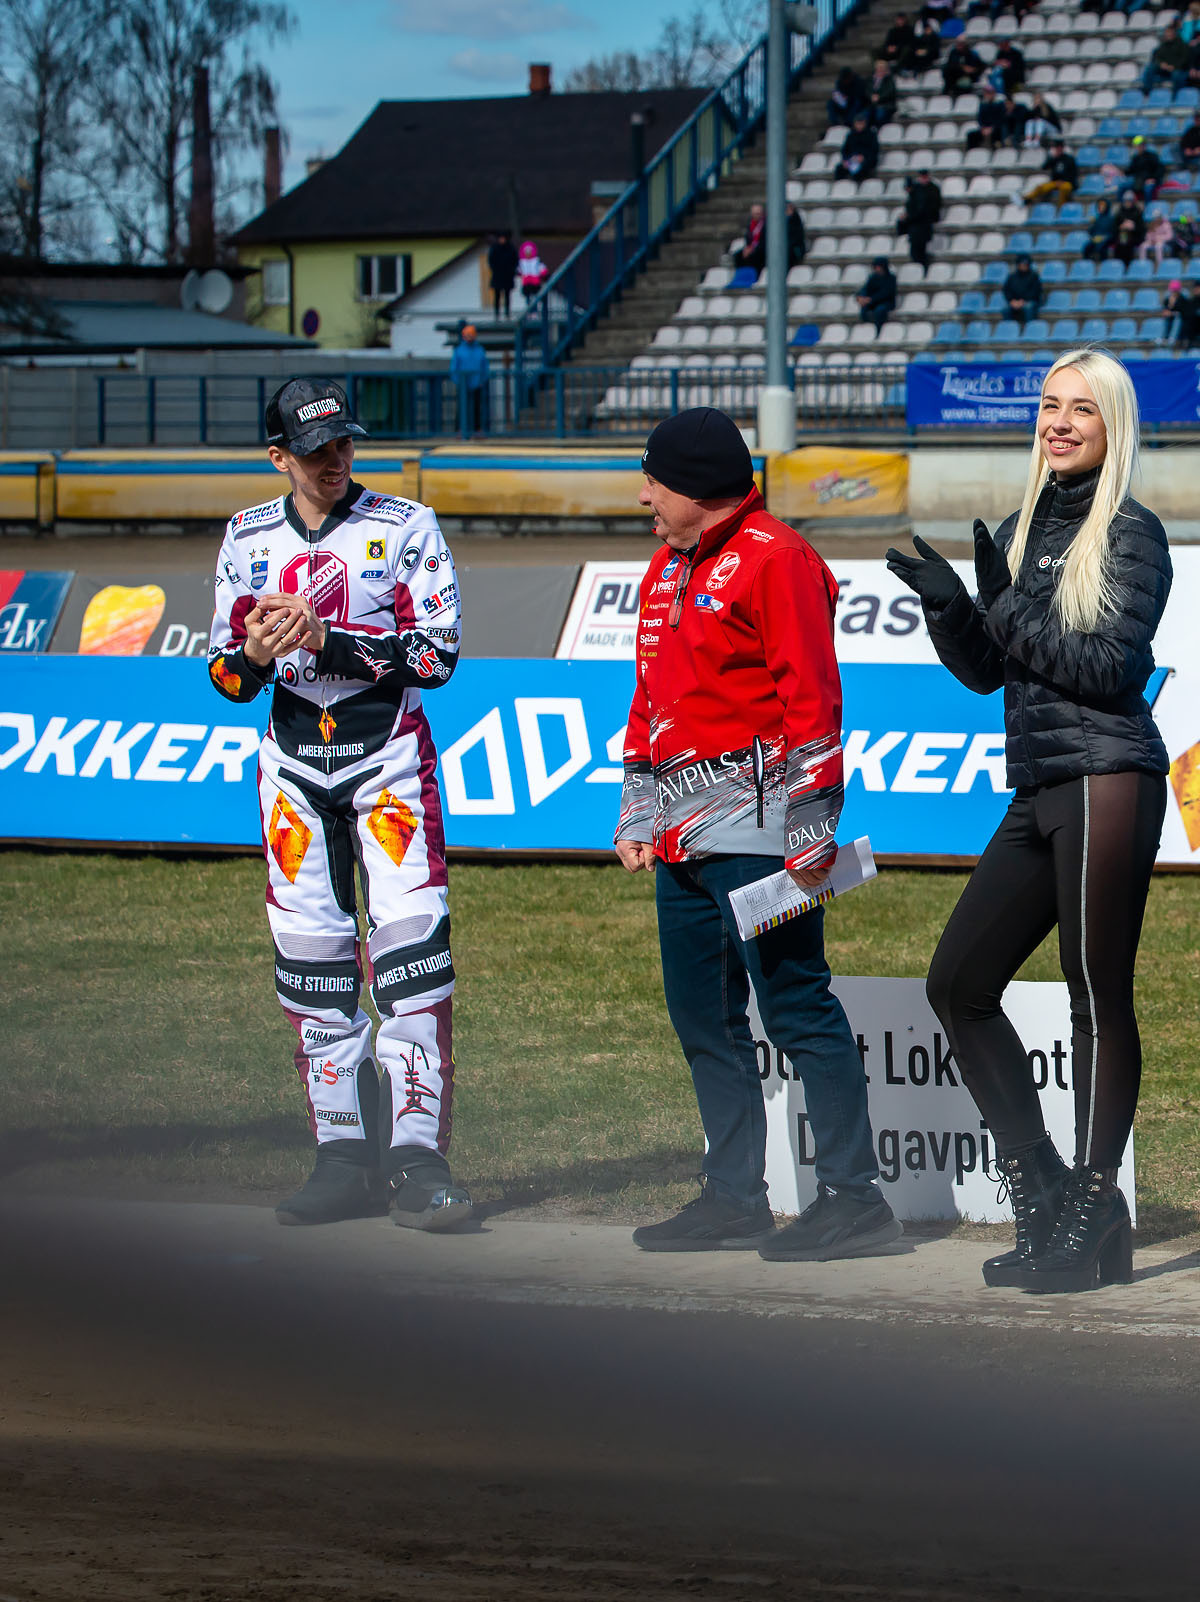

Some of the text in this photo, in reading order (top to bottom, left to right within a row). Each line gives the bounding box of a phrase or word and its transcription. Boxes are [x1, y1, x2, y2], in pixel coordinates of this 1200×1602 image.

[304, 975, 355, 992] STUDIOS
[376, 949, 452, 990] AMBER STUDIOS
